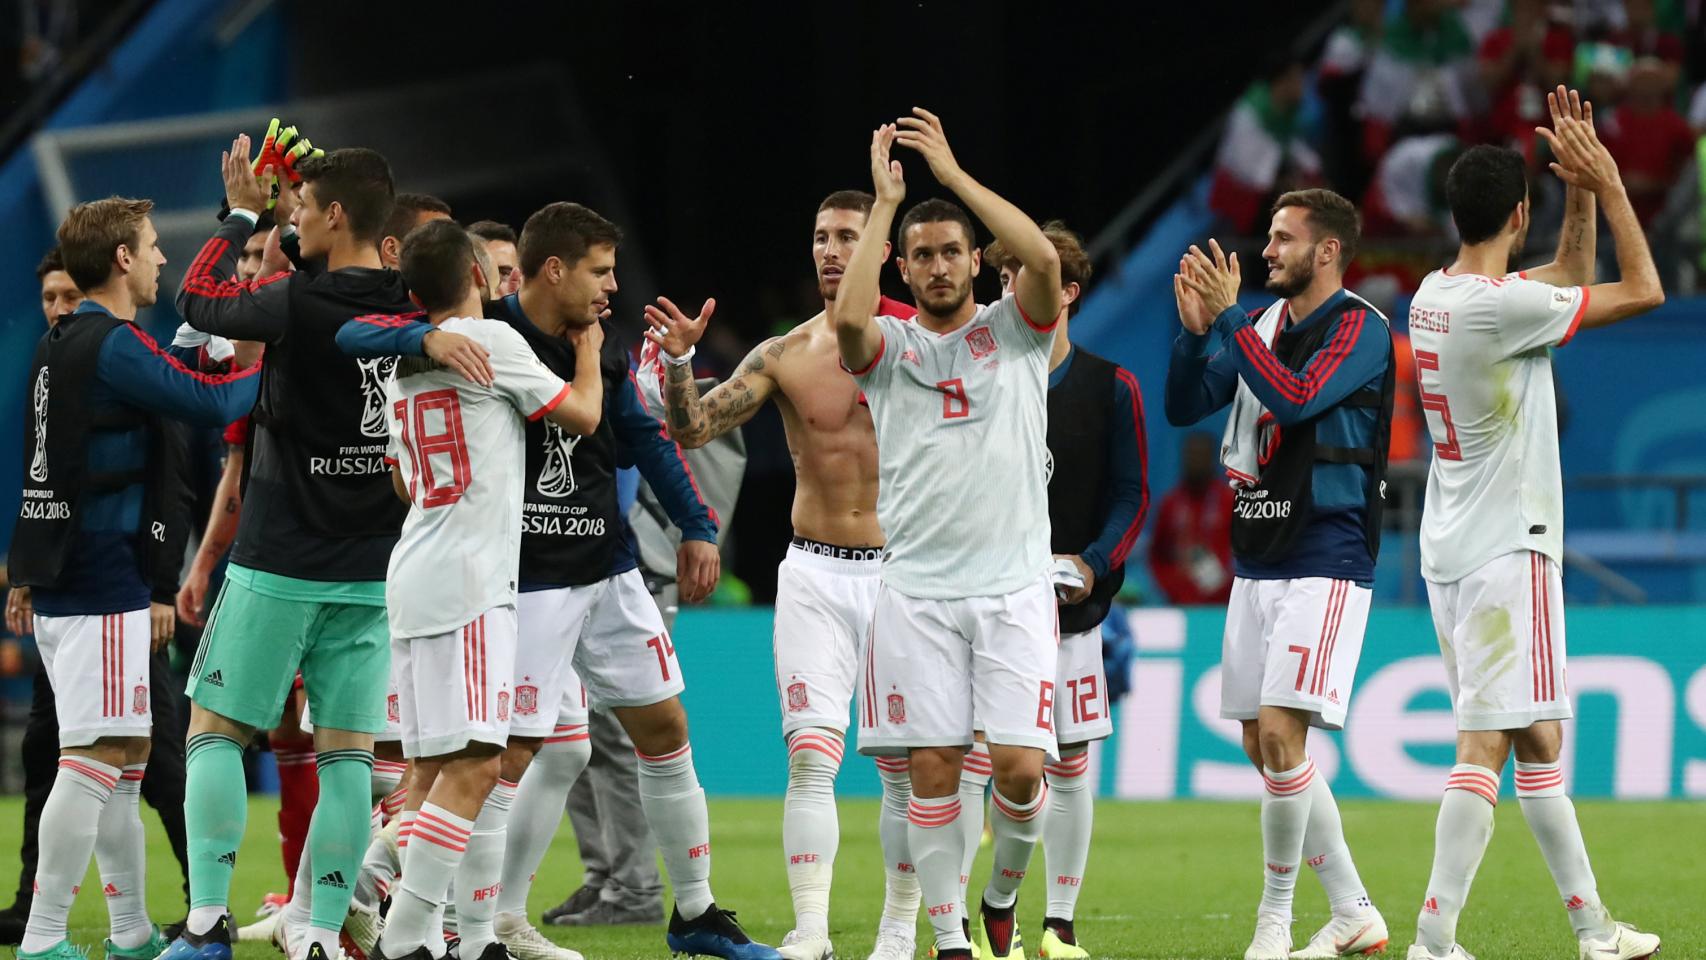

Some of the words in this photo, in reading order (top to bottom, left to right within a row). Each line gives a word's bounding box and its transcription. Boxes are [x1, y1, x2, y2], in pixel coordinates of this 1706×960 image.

[1414, 349, 1464, 461] 5
[339, 446, 359, 454] FIFA
[394, 388, 473, 509] 18
[310, 457, 386, 475] RUSSIA
[538, 504, 570, 514] WORLD
[570, 506, 588, 515] CUP
[1253, 501, 1291, 519] 2018
[564, 518, 606, 536] 2018
[803, 541, 848, 559] NOBLE
[1288, 645, 1311, 692] 7
[1066, 675, 1099, 724] 12
